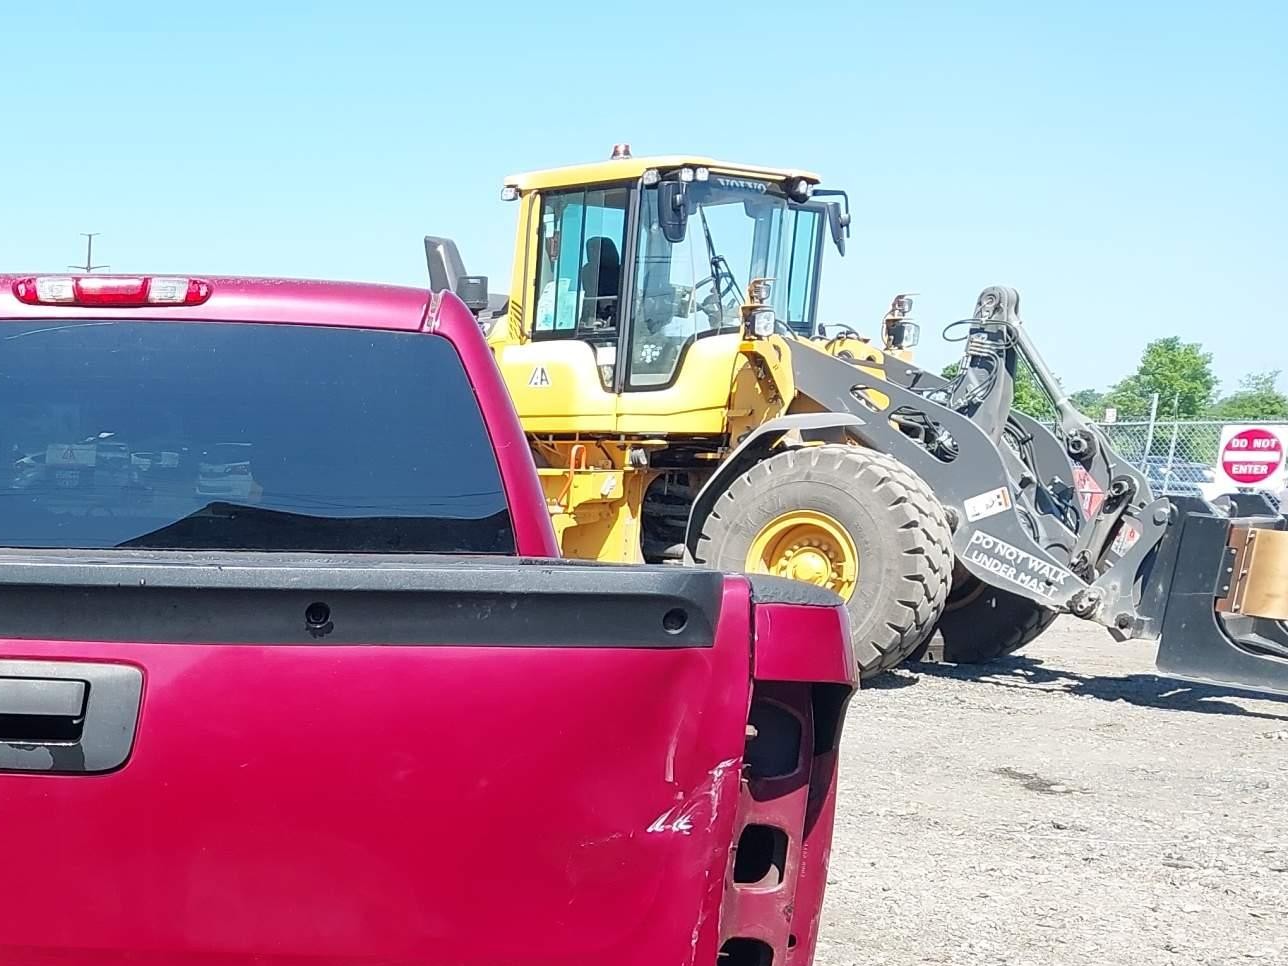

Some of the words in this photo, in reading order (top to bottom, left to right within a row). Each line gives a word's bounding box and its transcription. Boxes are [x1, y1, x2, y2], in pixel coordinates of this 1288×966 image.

[1231, 438, 1249, 449] DO
[1253, 438, 1278, 449] NOT
[1231, 464, 1269, 475] ENTER
[972, 533, 994, 549] DO
[994, 543, 1026, 564] NOT
[1027, 557, 1071, 585] WALK
[972, 550, 1017, 578] UNDER
[1017, 572, 1059, 597] MAST
